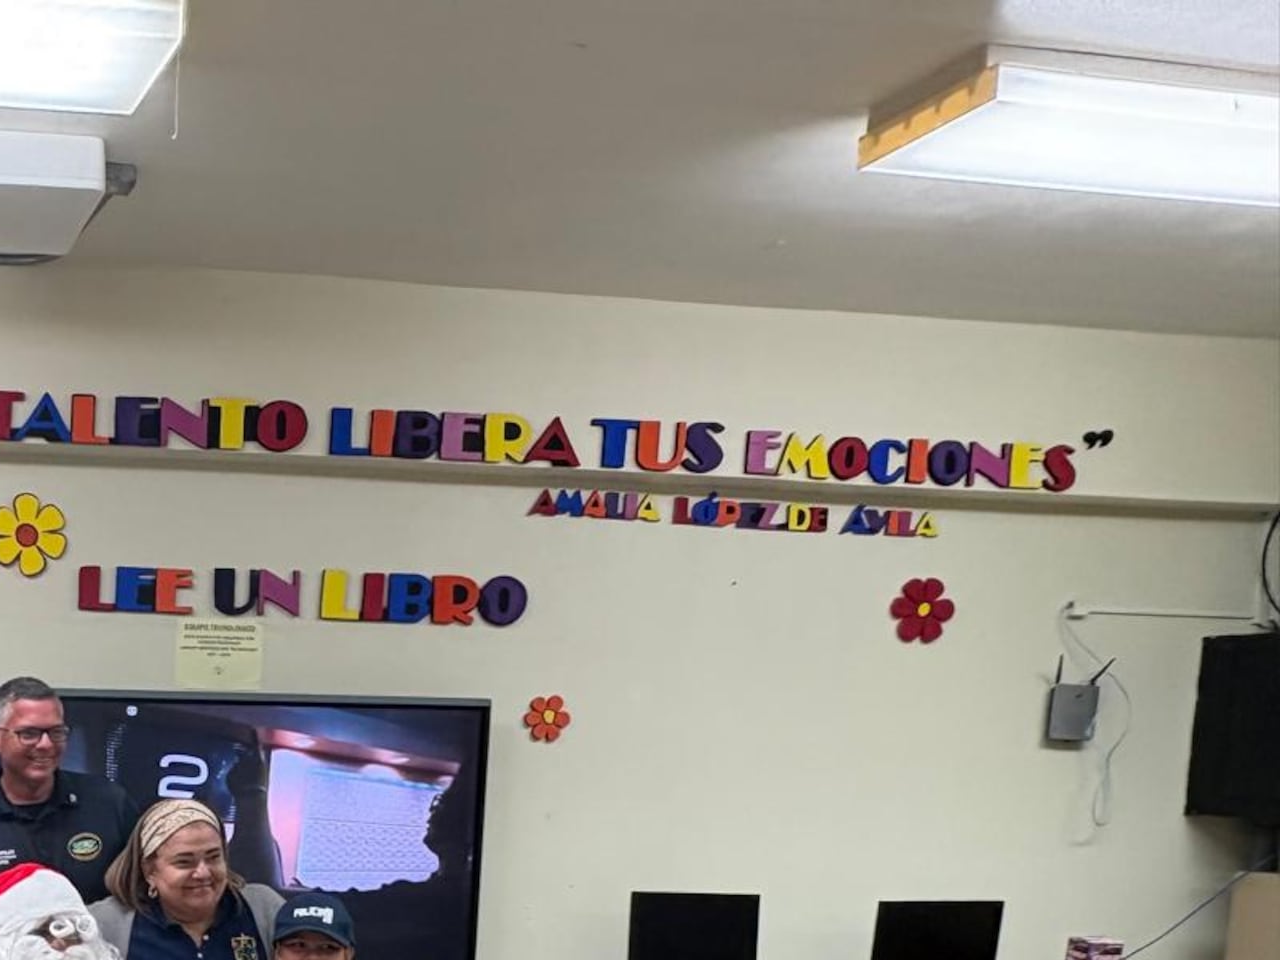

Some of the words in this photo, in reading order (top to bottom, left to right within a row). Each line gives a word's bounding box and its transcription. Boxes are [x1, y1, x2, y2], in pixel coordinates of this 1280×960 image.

[329, 407, 580, 467] LIBERA
[590, 417, 726, 473] TUS
[527, 488, 661, 523] AMALIA
[786, 505, 829, 533] DE
[78, 565, 193, 615] LEE
[213, 567, 300, 616] UN
[319, 568, 528, 626] LIBRO
